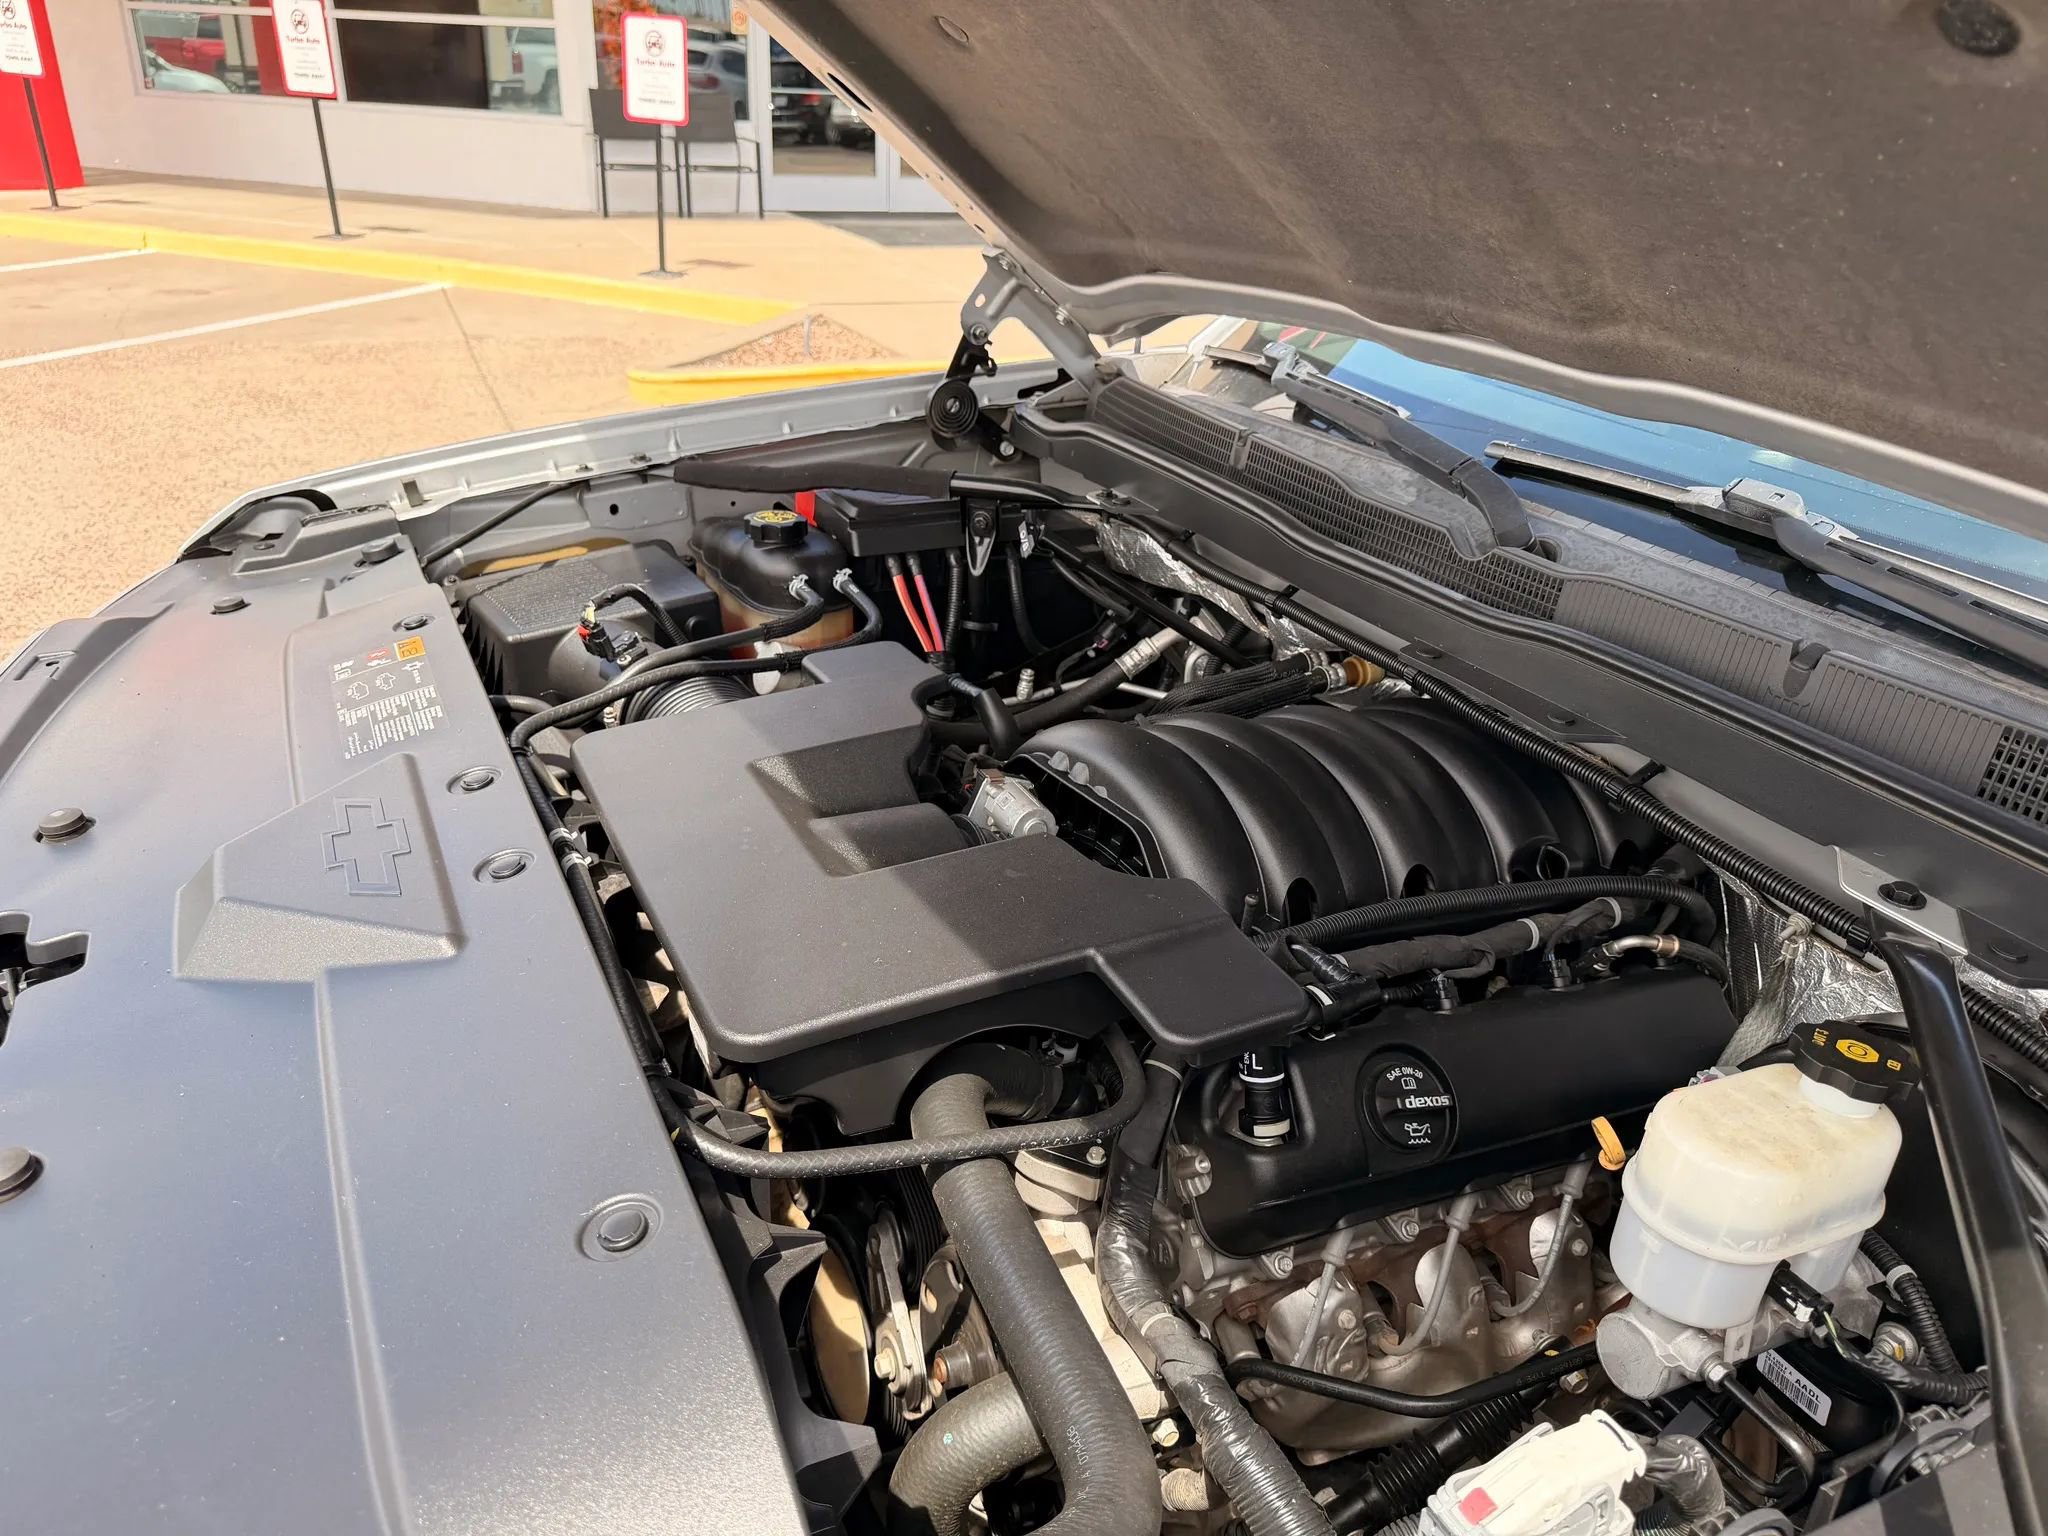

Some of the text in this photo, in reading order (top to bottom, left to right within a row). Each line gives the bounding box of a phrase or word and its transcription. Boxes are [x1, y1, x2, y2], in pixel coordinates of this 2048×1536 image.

[1252, 1053, 1263, 1070] L
[1386, 1066, 1424, 1081] SAE 0W-20
[1404, 1095, 1450, 1109] dexos
[1794, 1378, 1822, 1405] AADL
